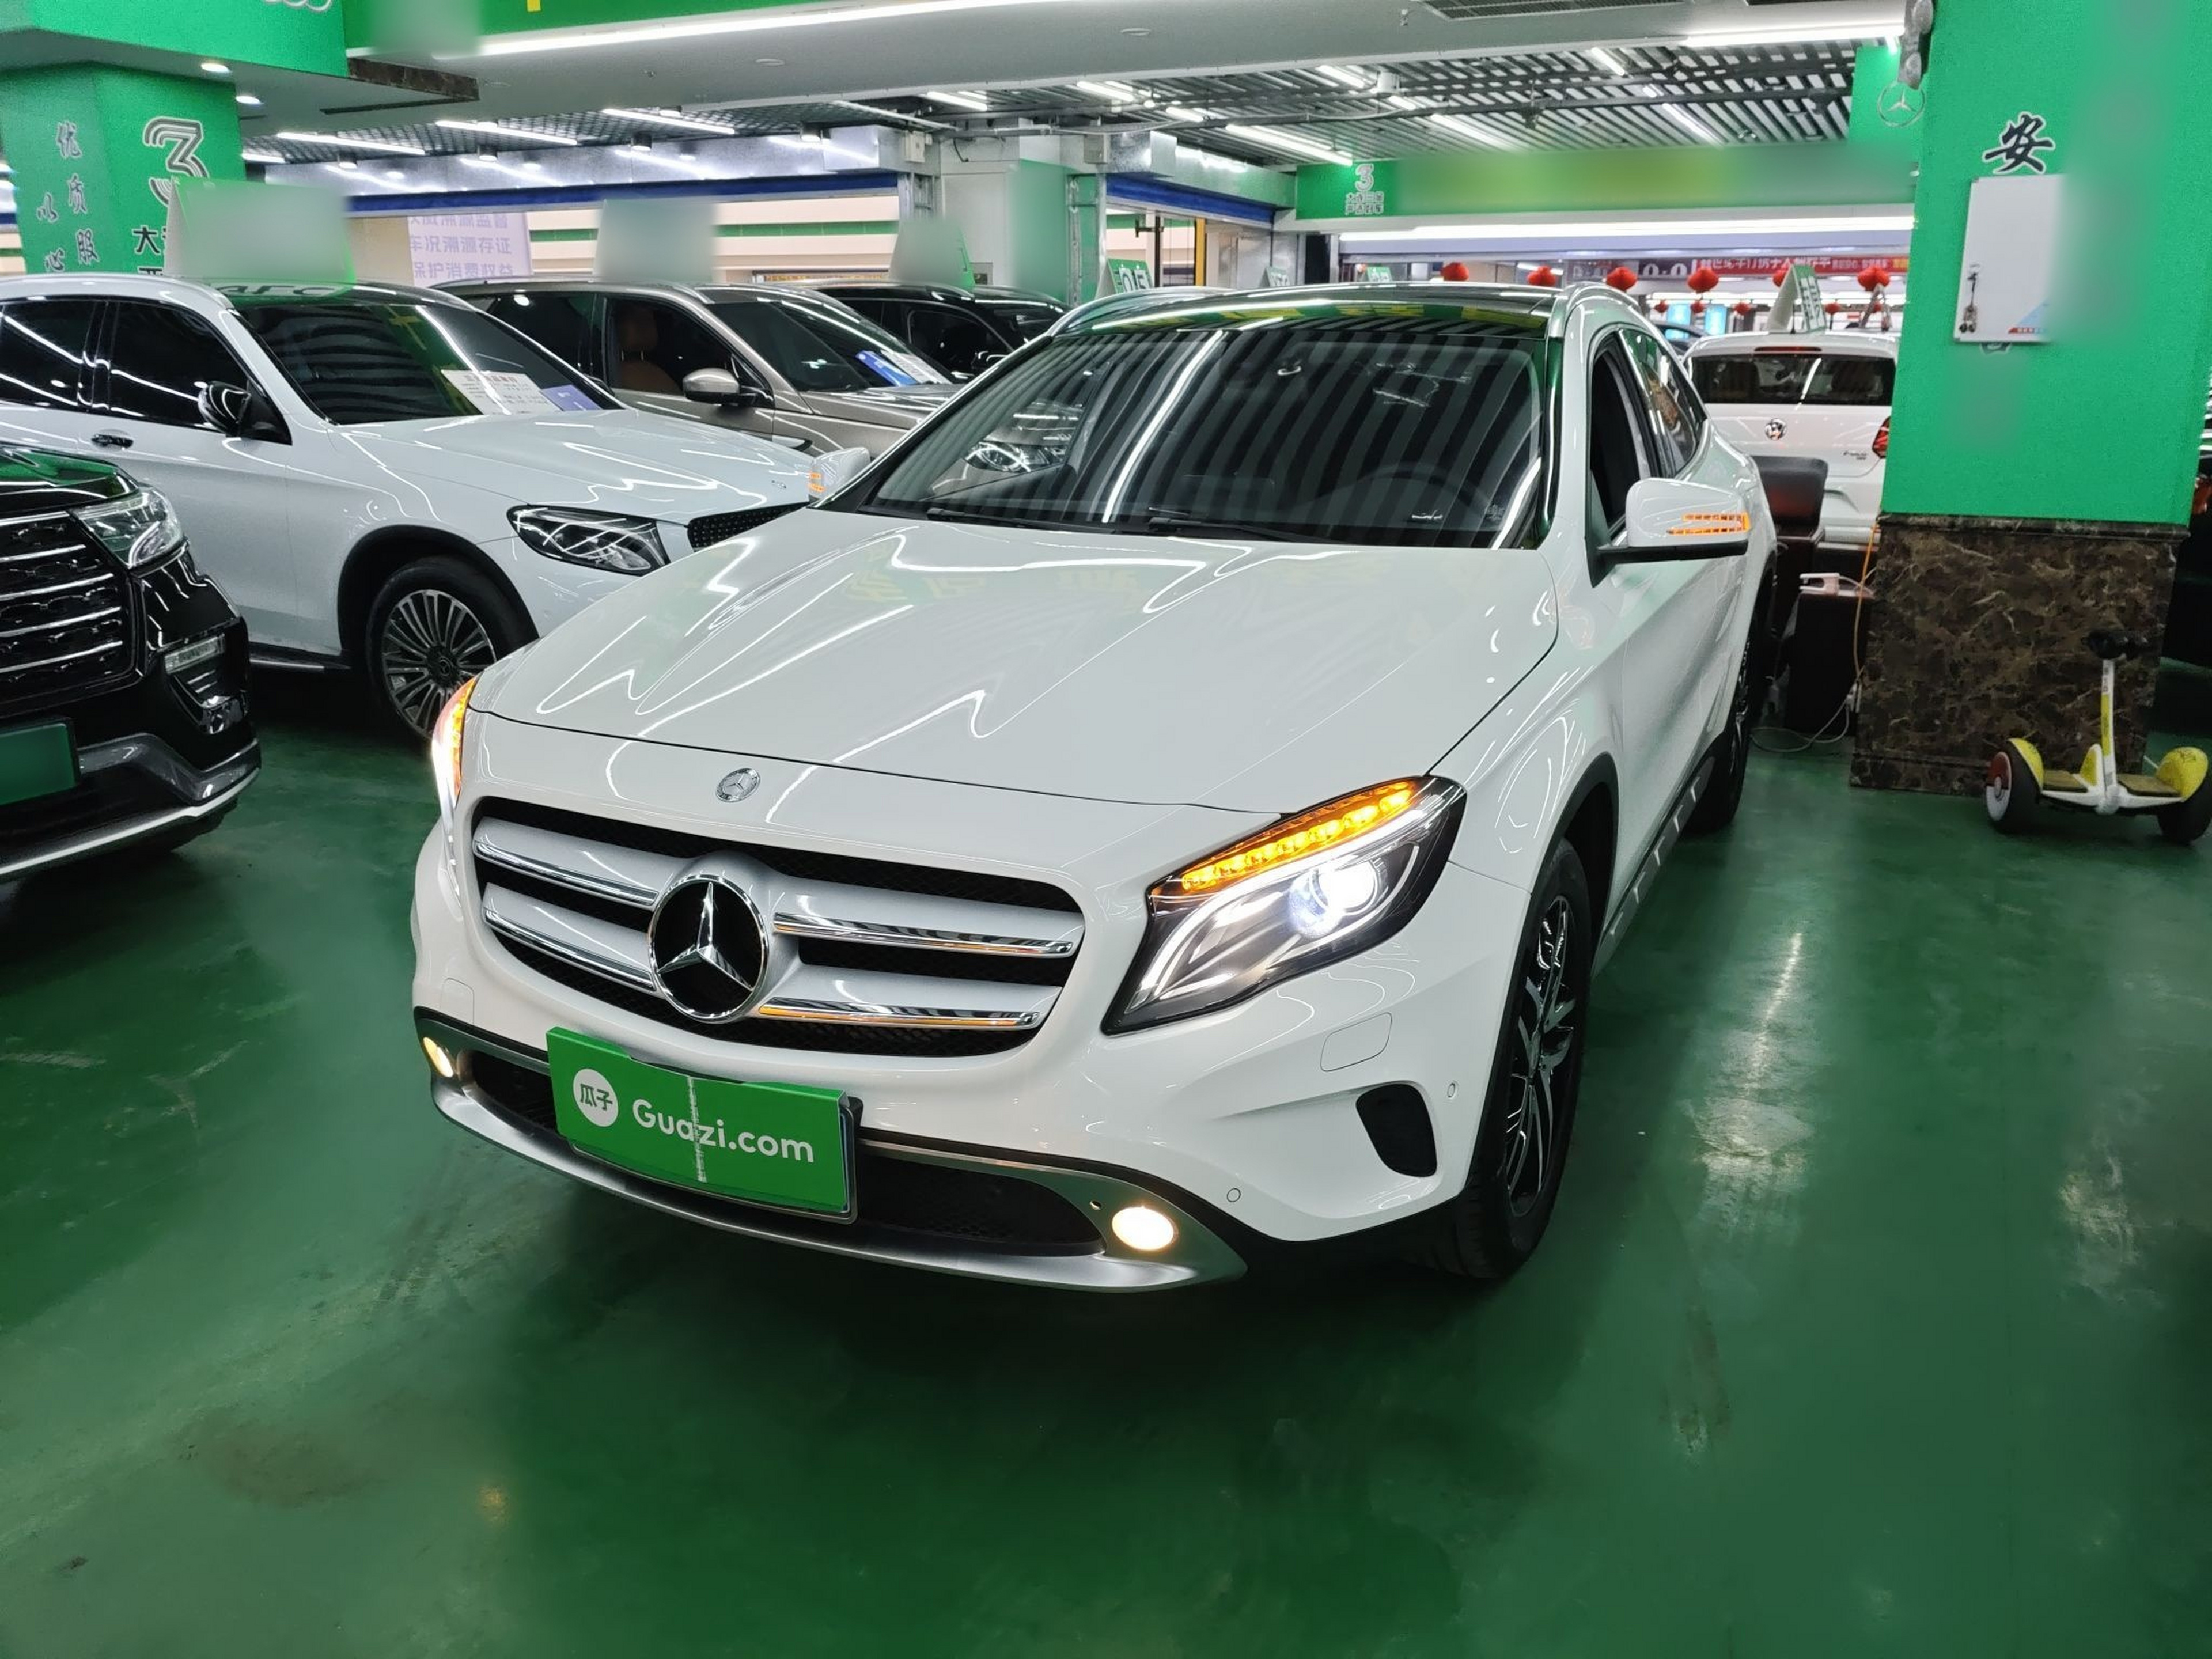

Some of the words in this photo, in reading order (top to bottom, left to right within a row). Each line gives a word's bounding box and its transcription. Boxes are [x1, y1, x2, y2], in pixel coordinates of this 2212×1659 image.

[1983, 112, 2054, 173] 安
[1354, 164, 1374, 192] 3
[579, 1083, 613, 1111] 瓜子
[633, 1099, 815, 1163] Guazi.com
